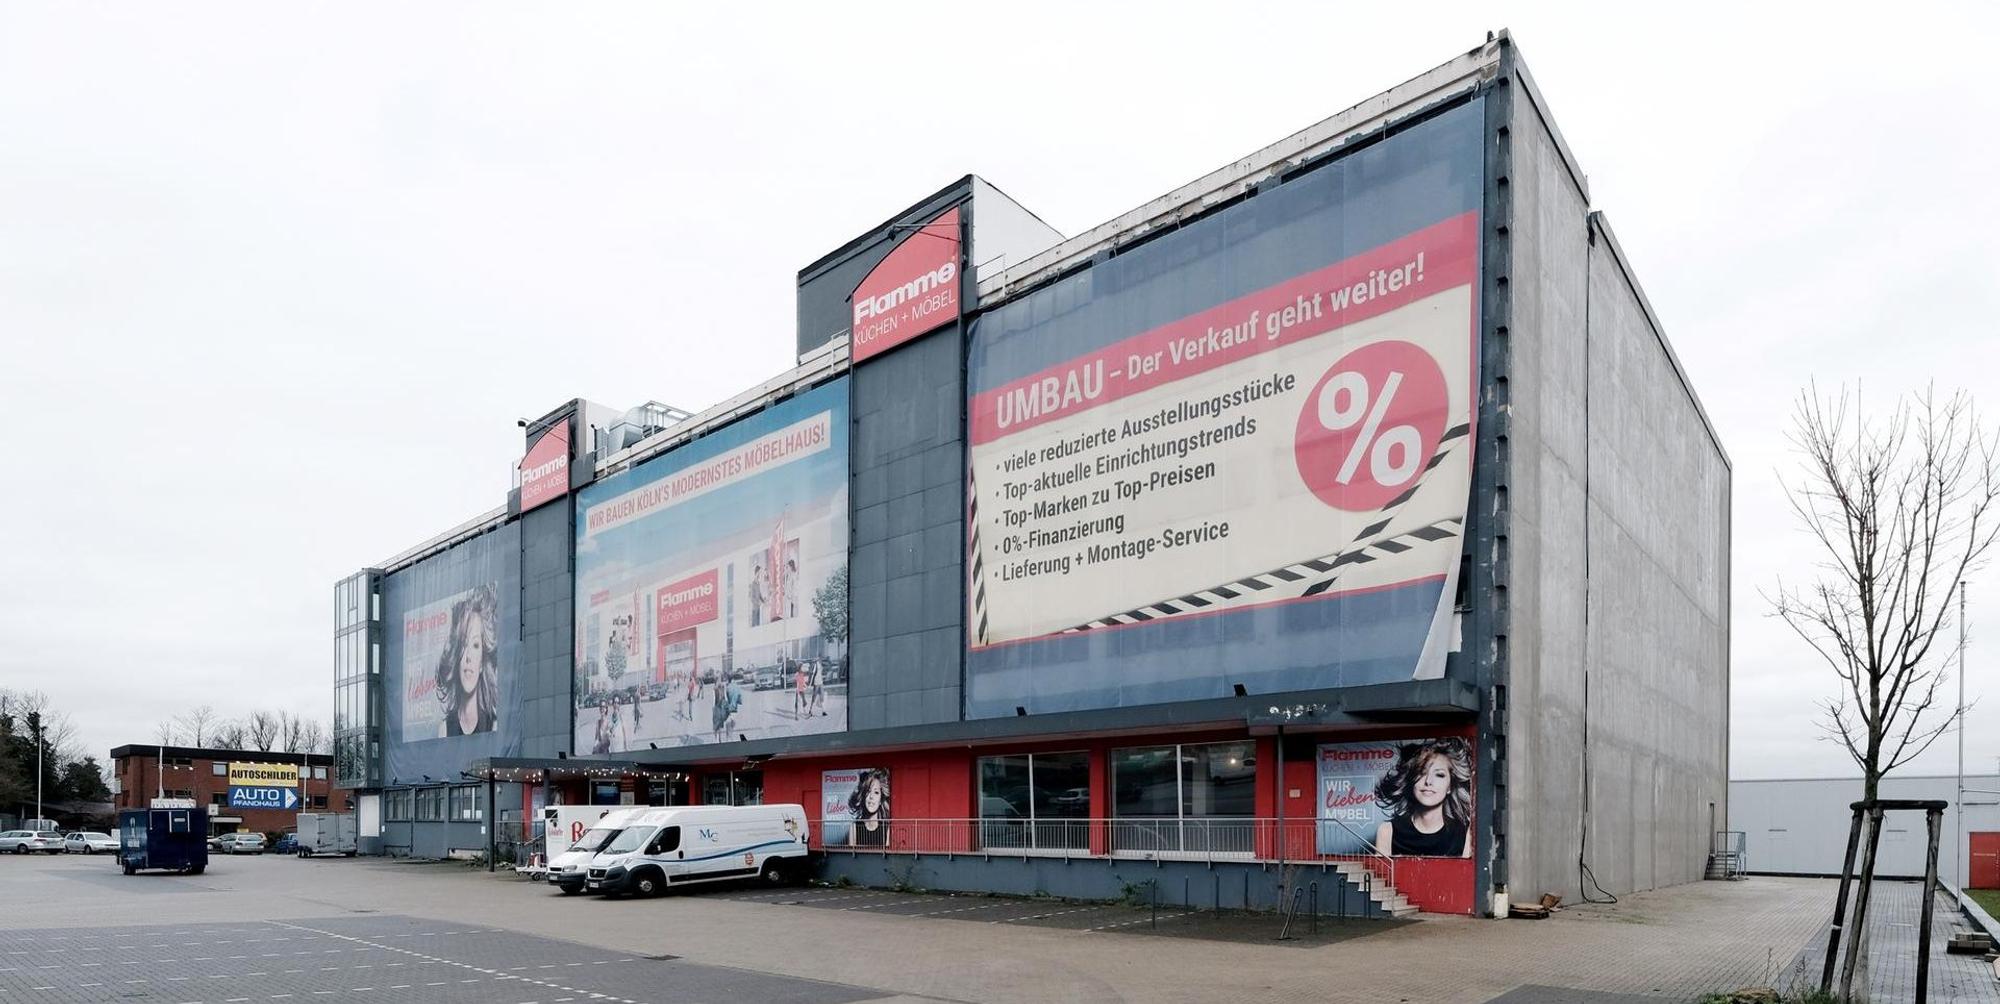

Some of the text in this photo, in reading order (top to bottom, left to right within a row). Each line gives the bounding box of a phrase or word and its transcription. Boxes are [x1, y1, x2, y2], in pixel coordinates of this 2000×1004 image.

[854, 314, 898, 347] KÜCHEN
[911, 289, 956, 321] MÖBEL
[855, 262, 956, 325] Flamme
[996, 359, 1104, 429] UMBAU
[1127, 350, 1163, 381] Der
[1167, 310, 1260, 365] Verkauf
[1266, 292, 1323, 340] geht
[1329, 251, 1425, 313] weiter!
[1003, 372, 1296, 473] viele reduzierte Ausstellungsstücke
[1317, 371, 1422, 487] %
[521, 454, 567, 486] Flamme
[589, 423, 825, 529] WIR BAUEN KÖLN'S MODERNSTES MÖBELHAUS!
[1003, 414, 1257, 501] Top-aktuelle Einrichtungstrends
[1003, 461, 1216, 528] Top-Marken zu Top-Preisen
[1002, 513, 1125, 555] 0%-Finanzierung
[1002, 555, 1071, 582] Lieferung
[1087, 522, 1230, 565] Montage-Service
[661, 582, 713, 609] Flamme
[231, 769, 297, 780] AUTOSCHILDER
[1322, 749, 1394, 762] Flamme
[234, 788, 280, 801] AUTO
[1326, 780, 1351, 792] WIR
[1326, 786, 1376, 808] lieben
